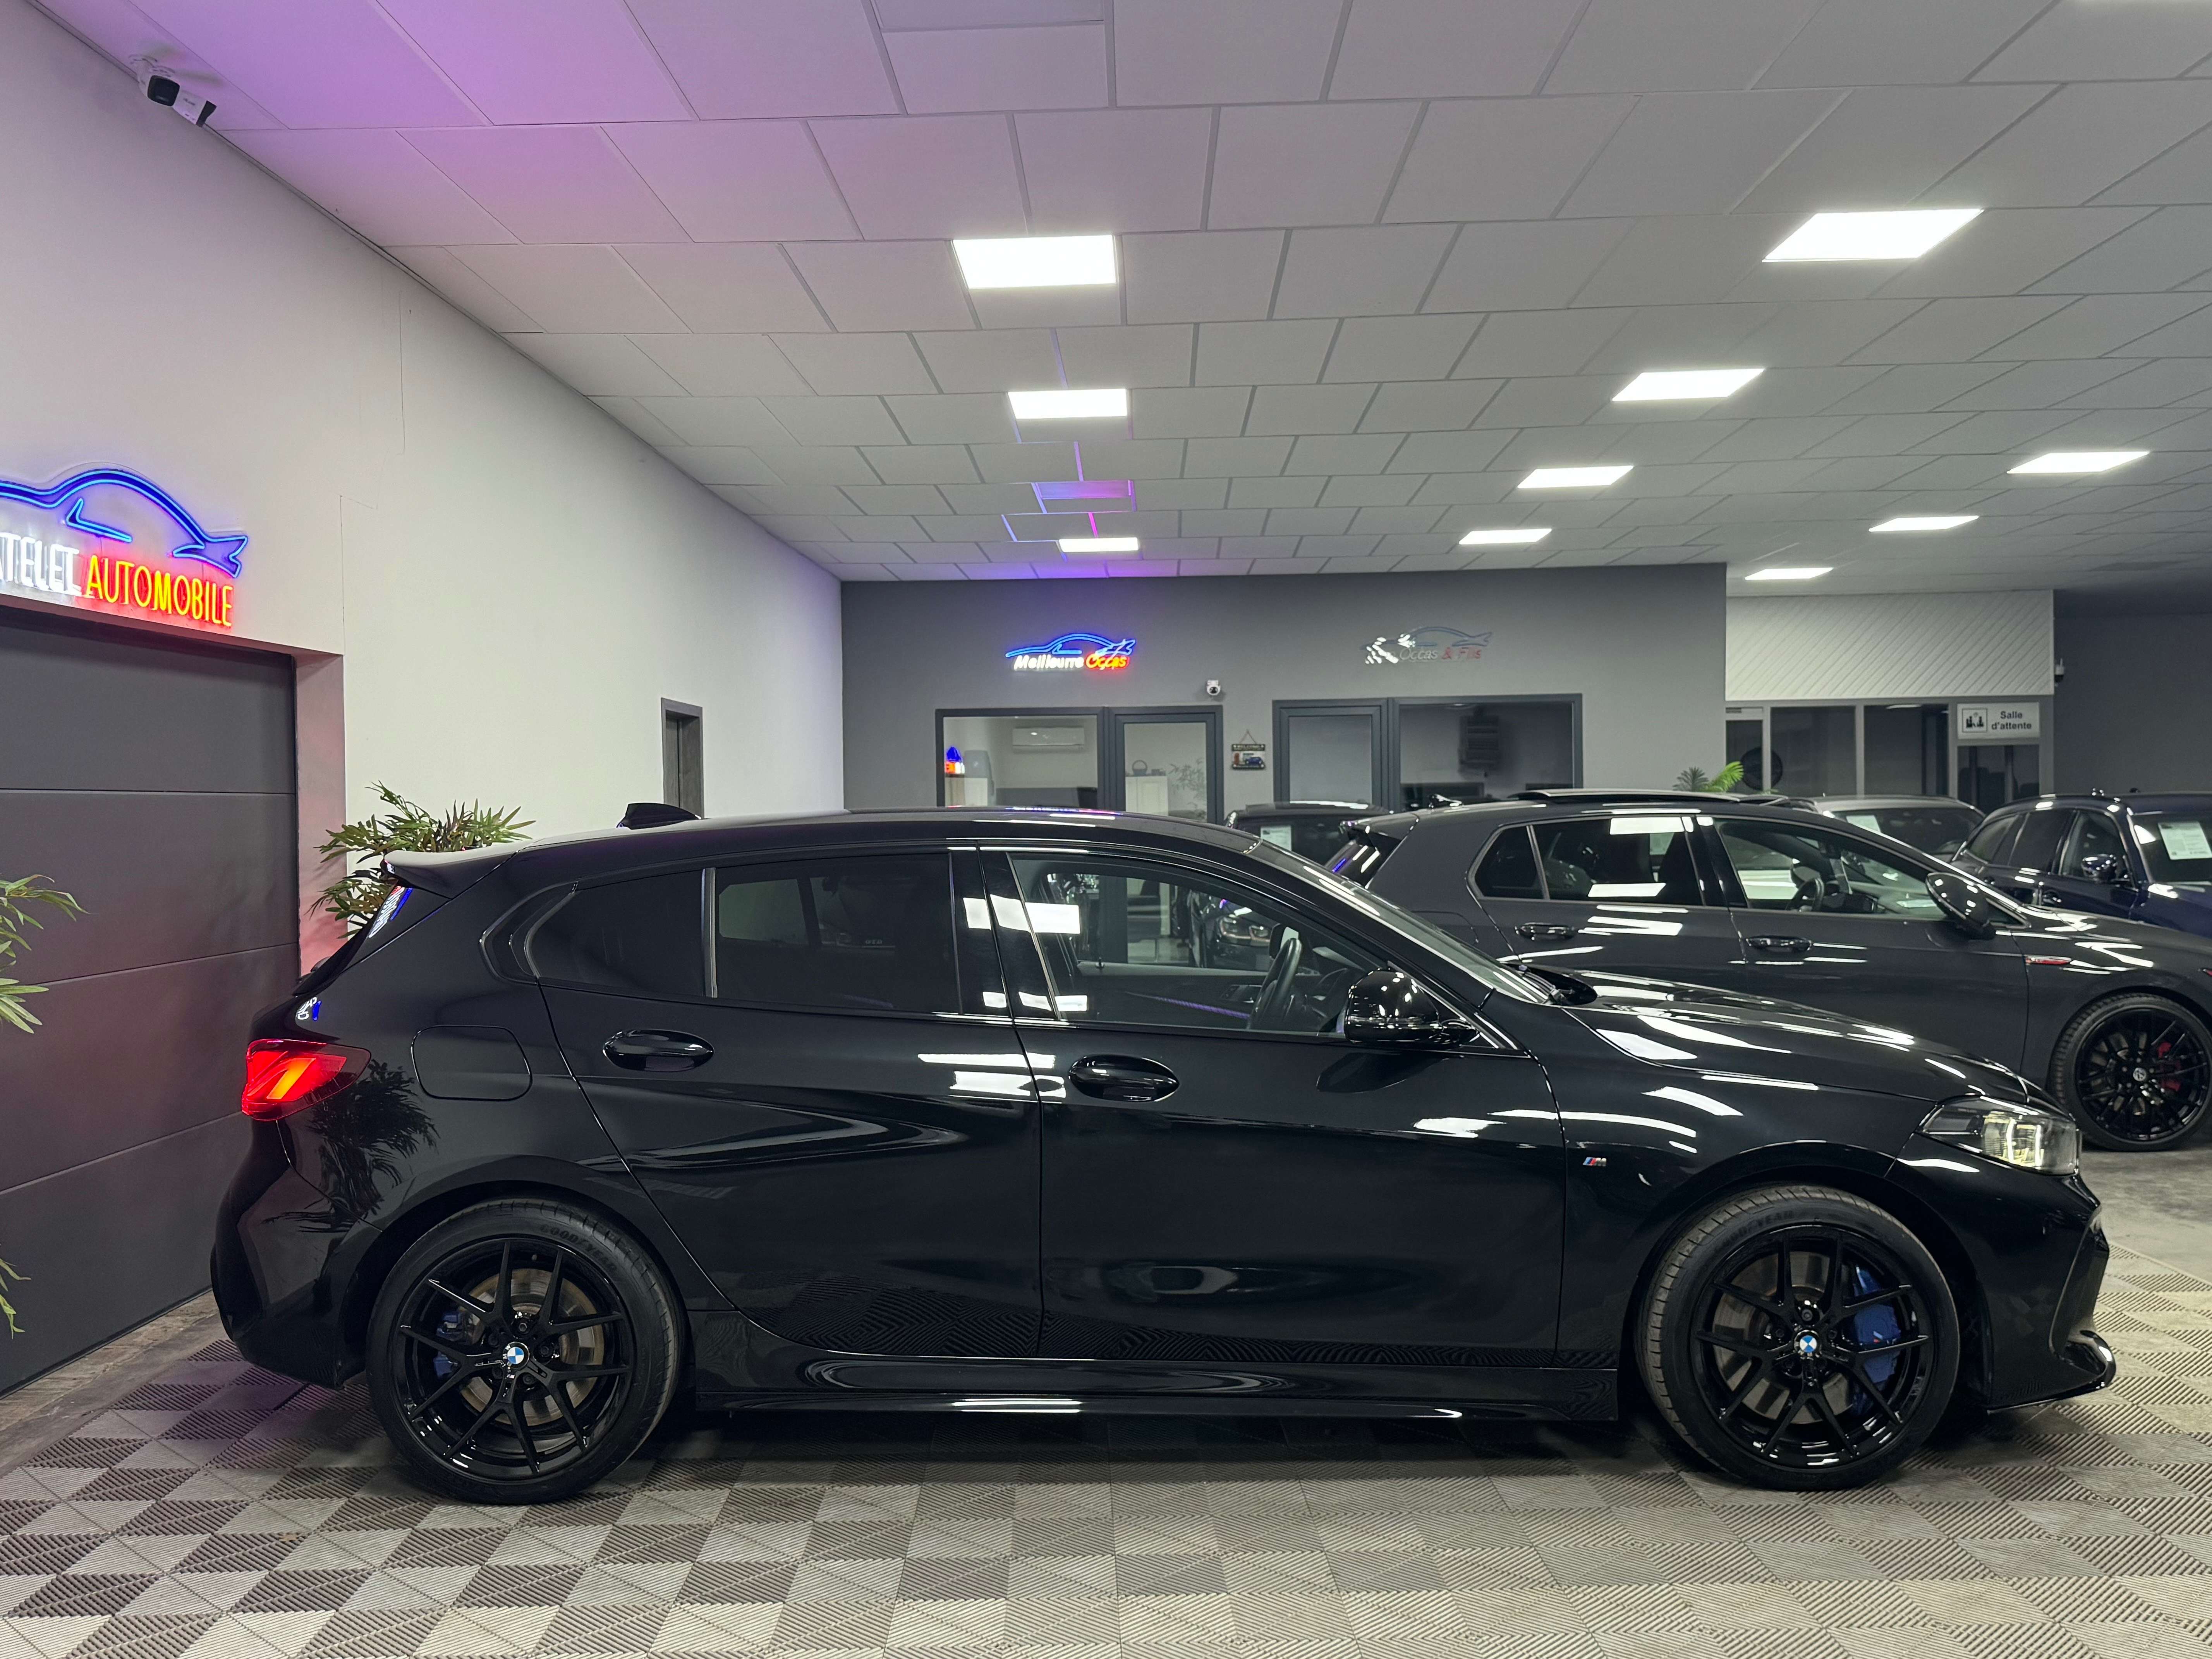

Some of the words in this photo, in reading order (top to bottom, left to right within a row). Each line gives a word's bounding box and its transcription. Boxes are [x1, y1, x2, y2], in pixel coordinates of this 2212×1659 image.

[0, 532, 82, 596] TELET
[86, 555, 234, 627] AUTOMOBILE
[1399, 647, 1438, 660] Occas
[2000, 710, 2023, 719] Salle
[1991, 722, 2032, 730] d'attente
